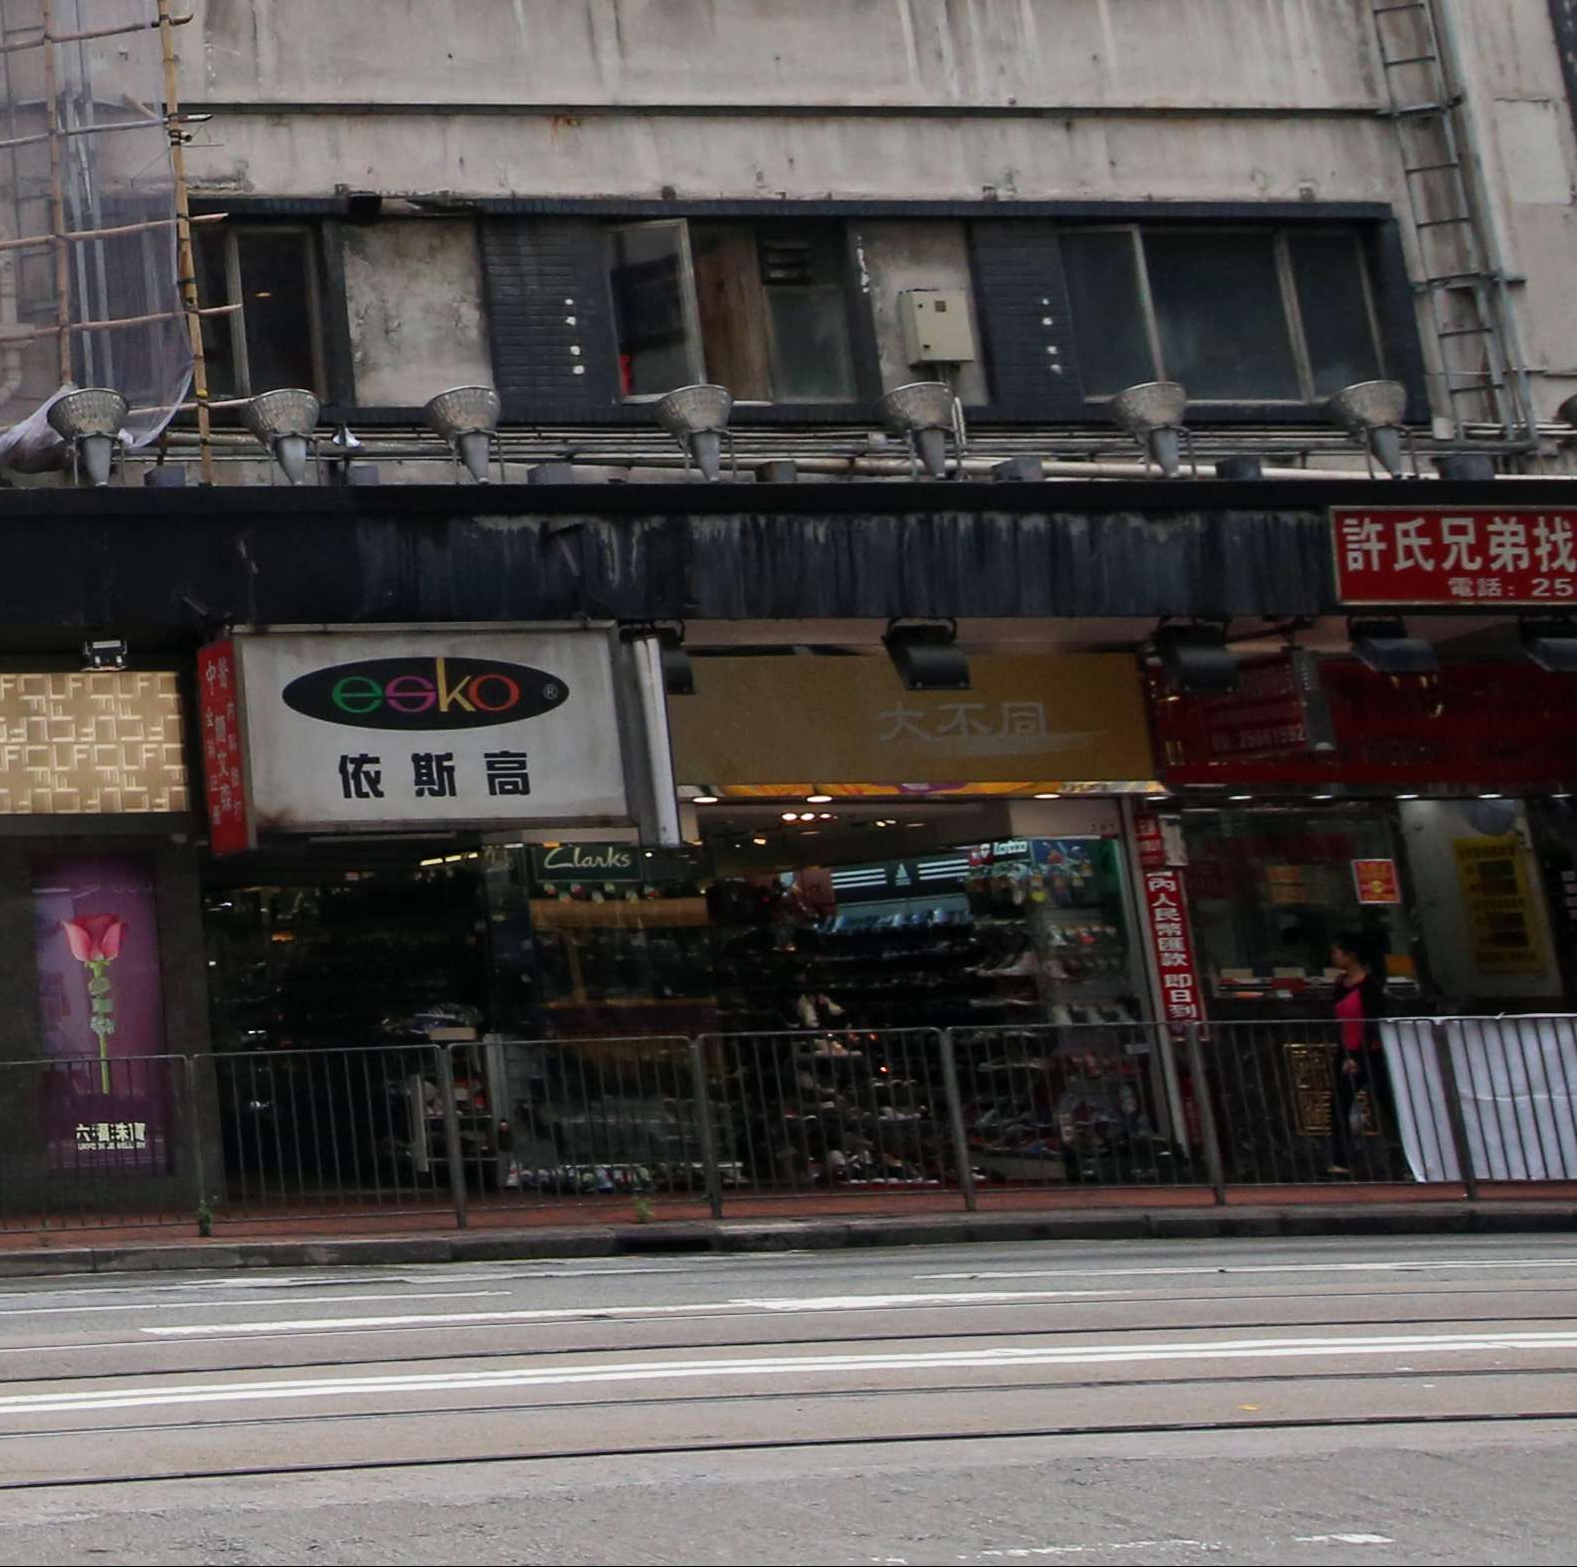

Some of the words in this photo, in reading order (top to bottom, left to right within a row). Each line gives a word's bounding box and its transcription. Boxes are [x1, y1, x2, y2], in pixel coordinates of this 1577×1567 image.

[1342, 516, 1577, 573] 許氏兄弟找
[332, 657, 519, 713] esko
[878, 700, 1050, 745] 大不同
[339, 750, 532, 799] 依斯高
[543, 845, 631, 869] Clarks
[1164, 974, 1200, 1035] 即日到
